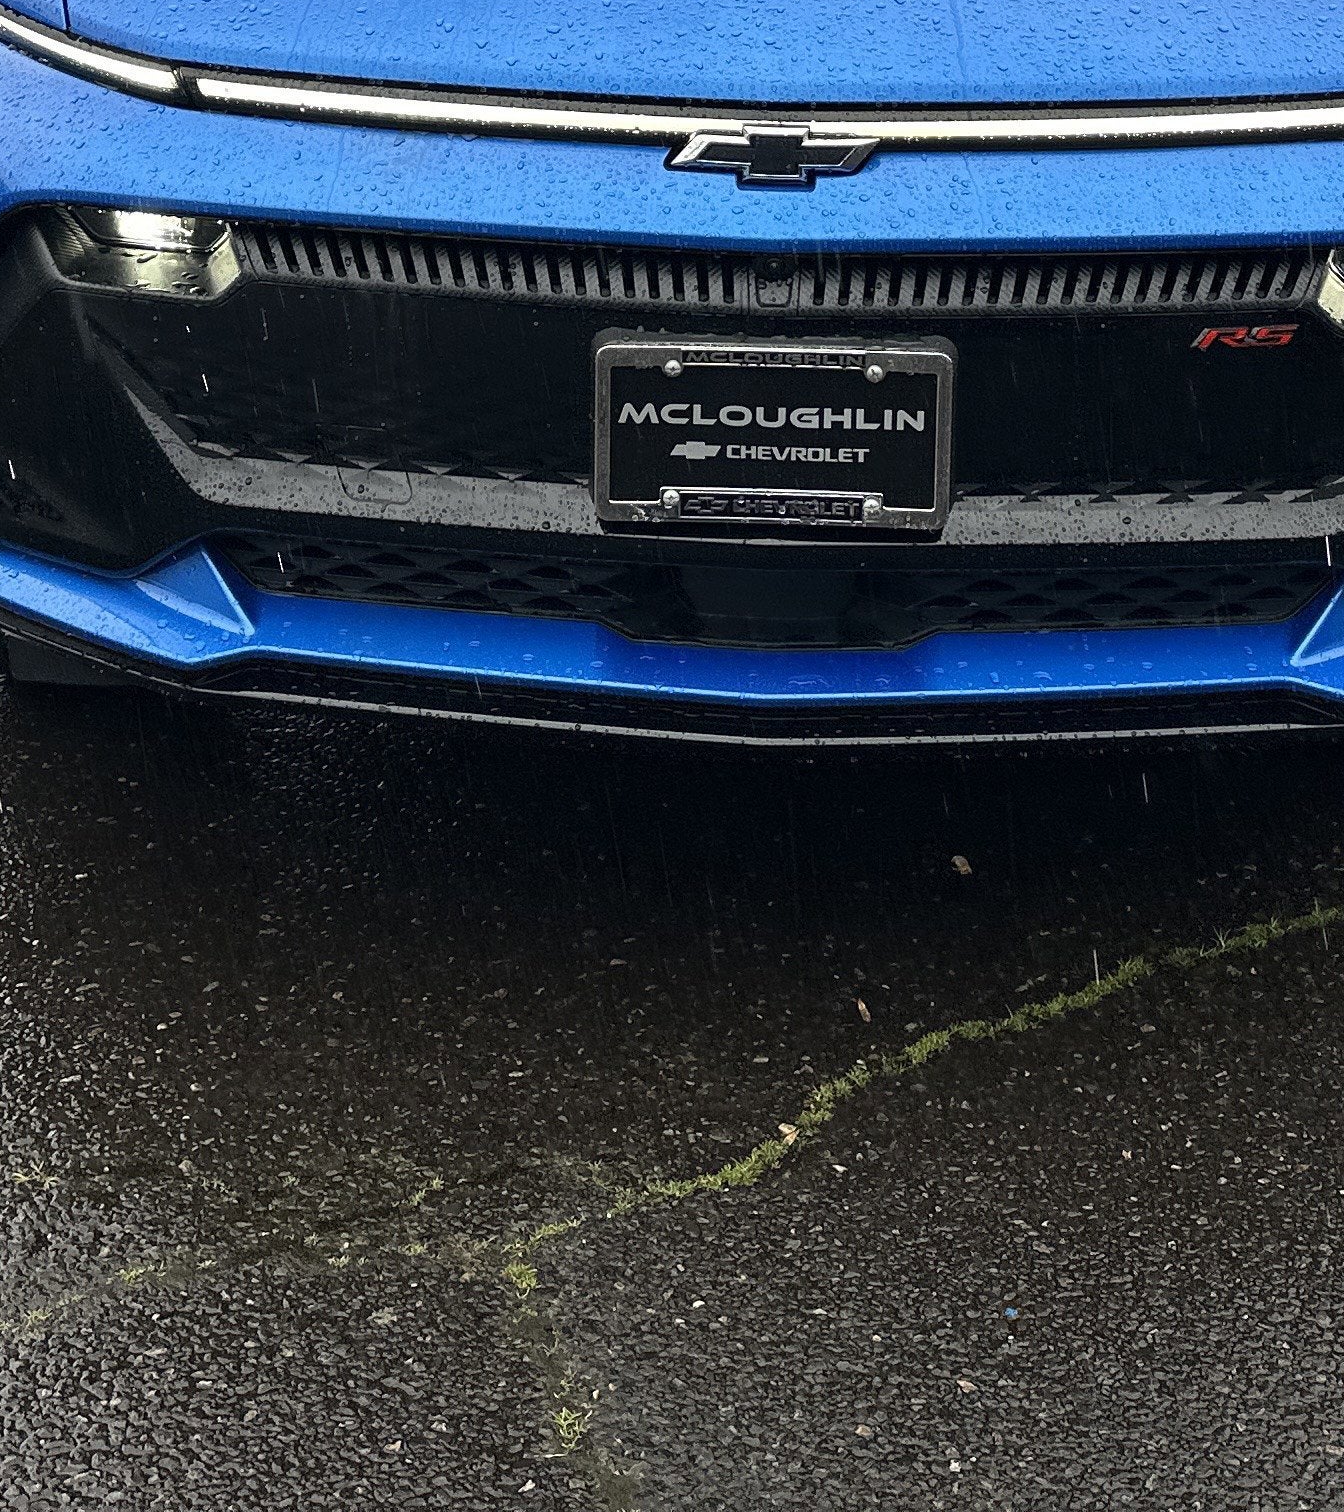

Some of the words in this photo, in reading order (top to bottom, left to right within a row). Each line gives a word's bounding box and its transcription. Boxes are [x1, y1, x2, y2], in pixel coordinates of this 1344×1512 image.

[1190, 324, 1300, 351] RS
[685, 351, 864, 367] MCLOUGHLIN
[617, 402, 926, 432] MCLOUGHLIN
[726, 444, 870, 463] CHEVROLET
[731, 497, 860, 518] CHEVROLET
